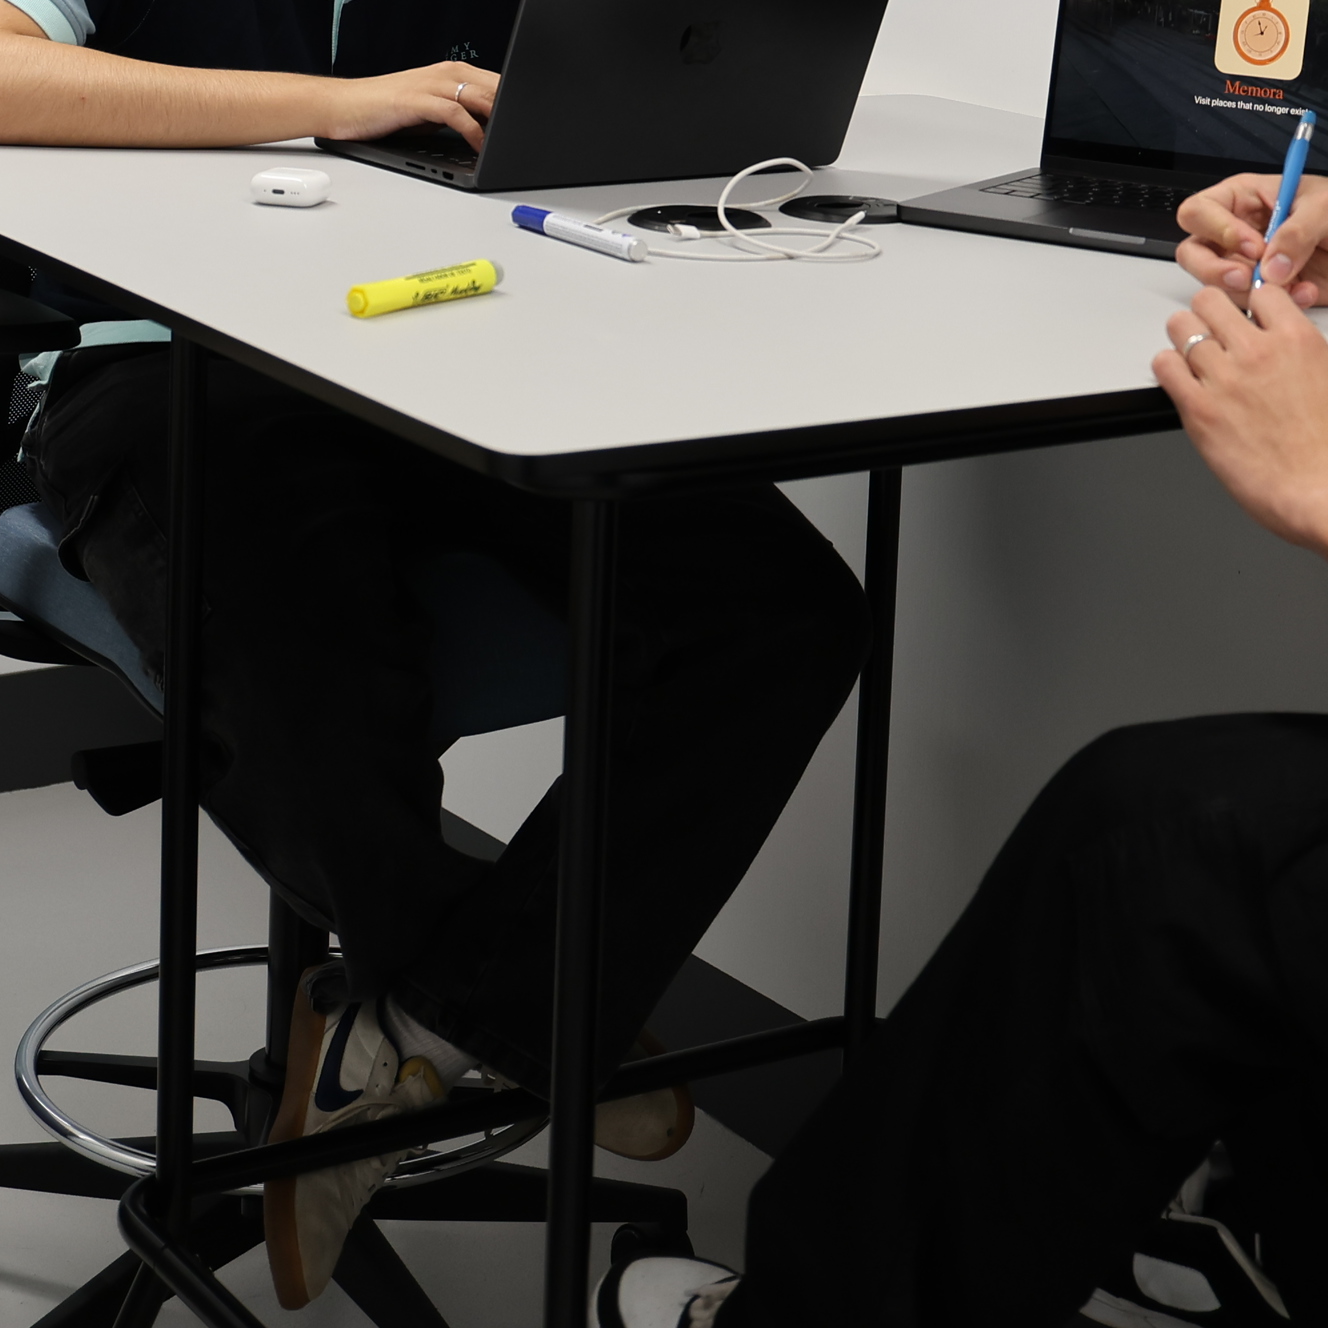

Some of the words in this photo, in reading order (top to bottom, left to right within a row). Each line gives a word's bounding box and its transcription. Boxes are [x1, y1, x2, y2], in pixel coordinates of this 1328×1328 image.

[1224, 79, 1285, 99] Memora
[1194, 95, 1211, 105] Visit
[1211, 98, 1236, 108] places
[1237, 101, 1253, 110] that
[1253, 103, 1265, 112] no
[1265, 104, 1289, 115] longer
